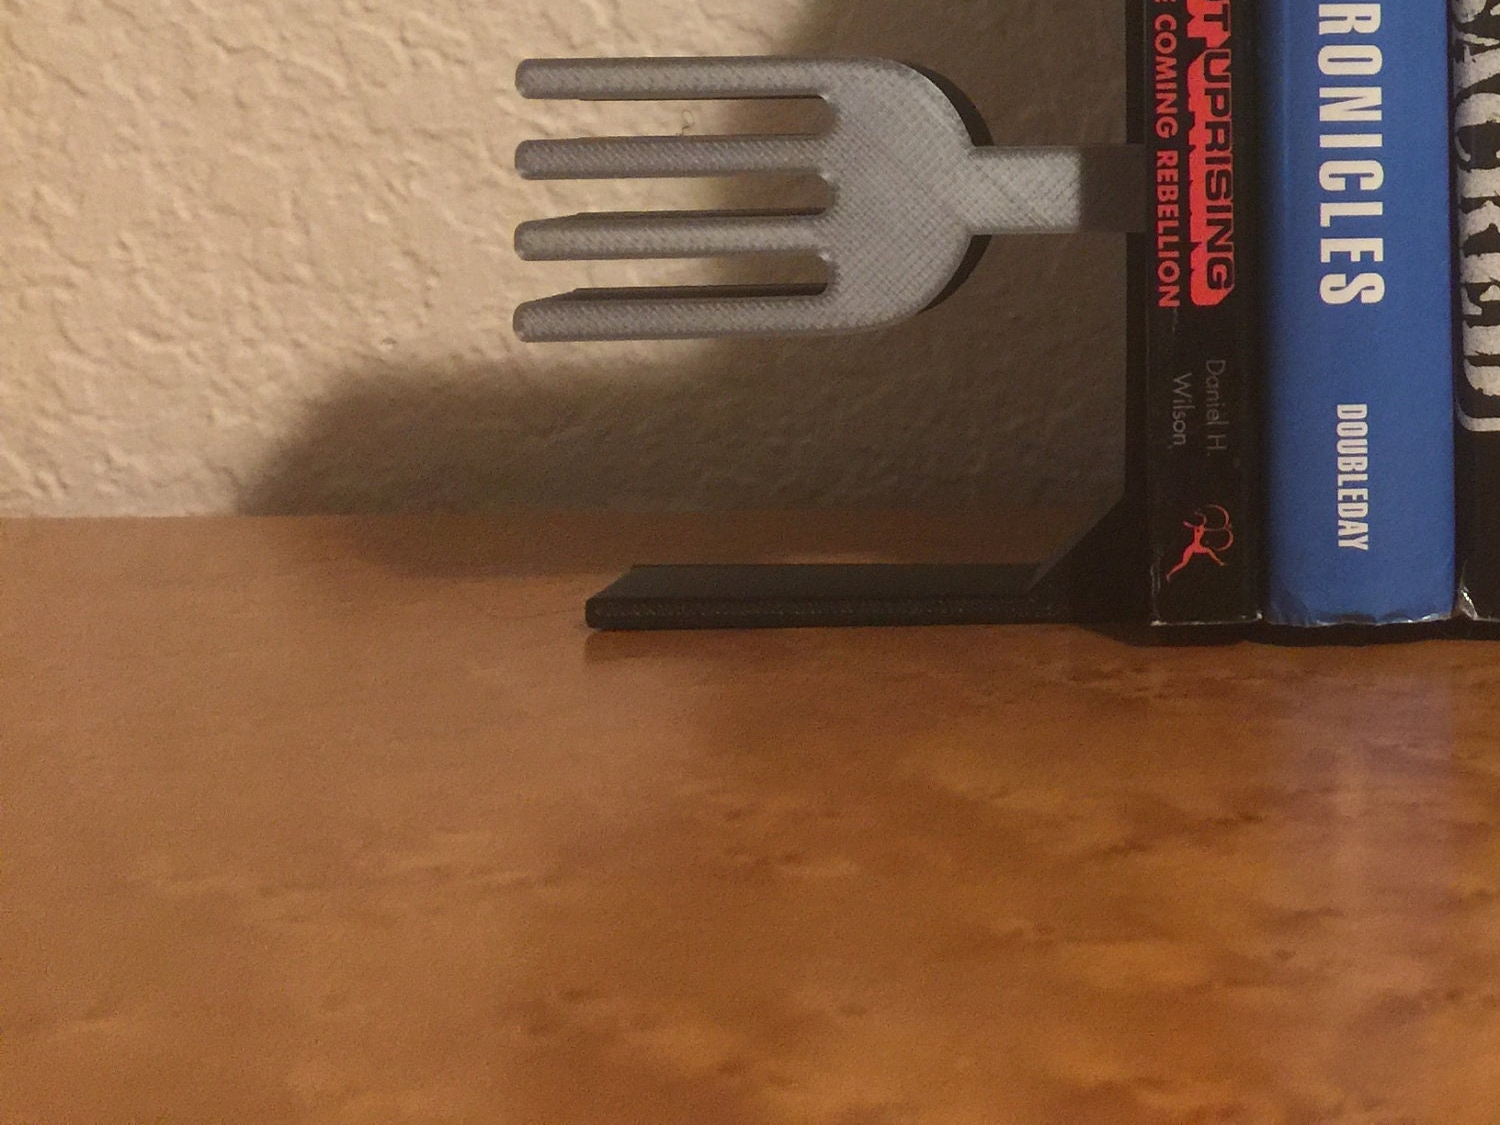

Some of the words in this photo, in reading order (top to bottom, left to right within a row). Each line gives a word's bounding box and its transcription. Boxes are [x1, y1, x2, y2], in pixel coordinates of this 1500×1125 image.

[1153, 14, 1178, 139] COMING
[1155, 149, 1181, 308] REBELLION
[1187, 48, 1235, 307] UPRISING
[1172, 372, 1195, 447] Wilson
[1204, 359, 1230, 427] Daniel
[1206, 435, 1227, 457] H.
[1335, 403, 1369, 552] DOUBLEDAY
